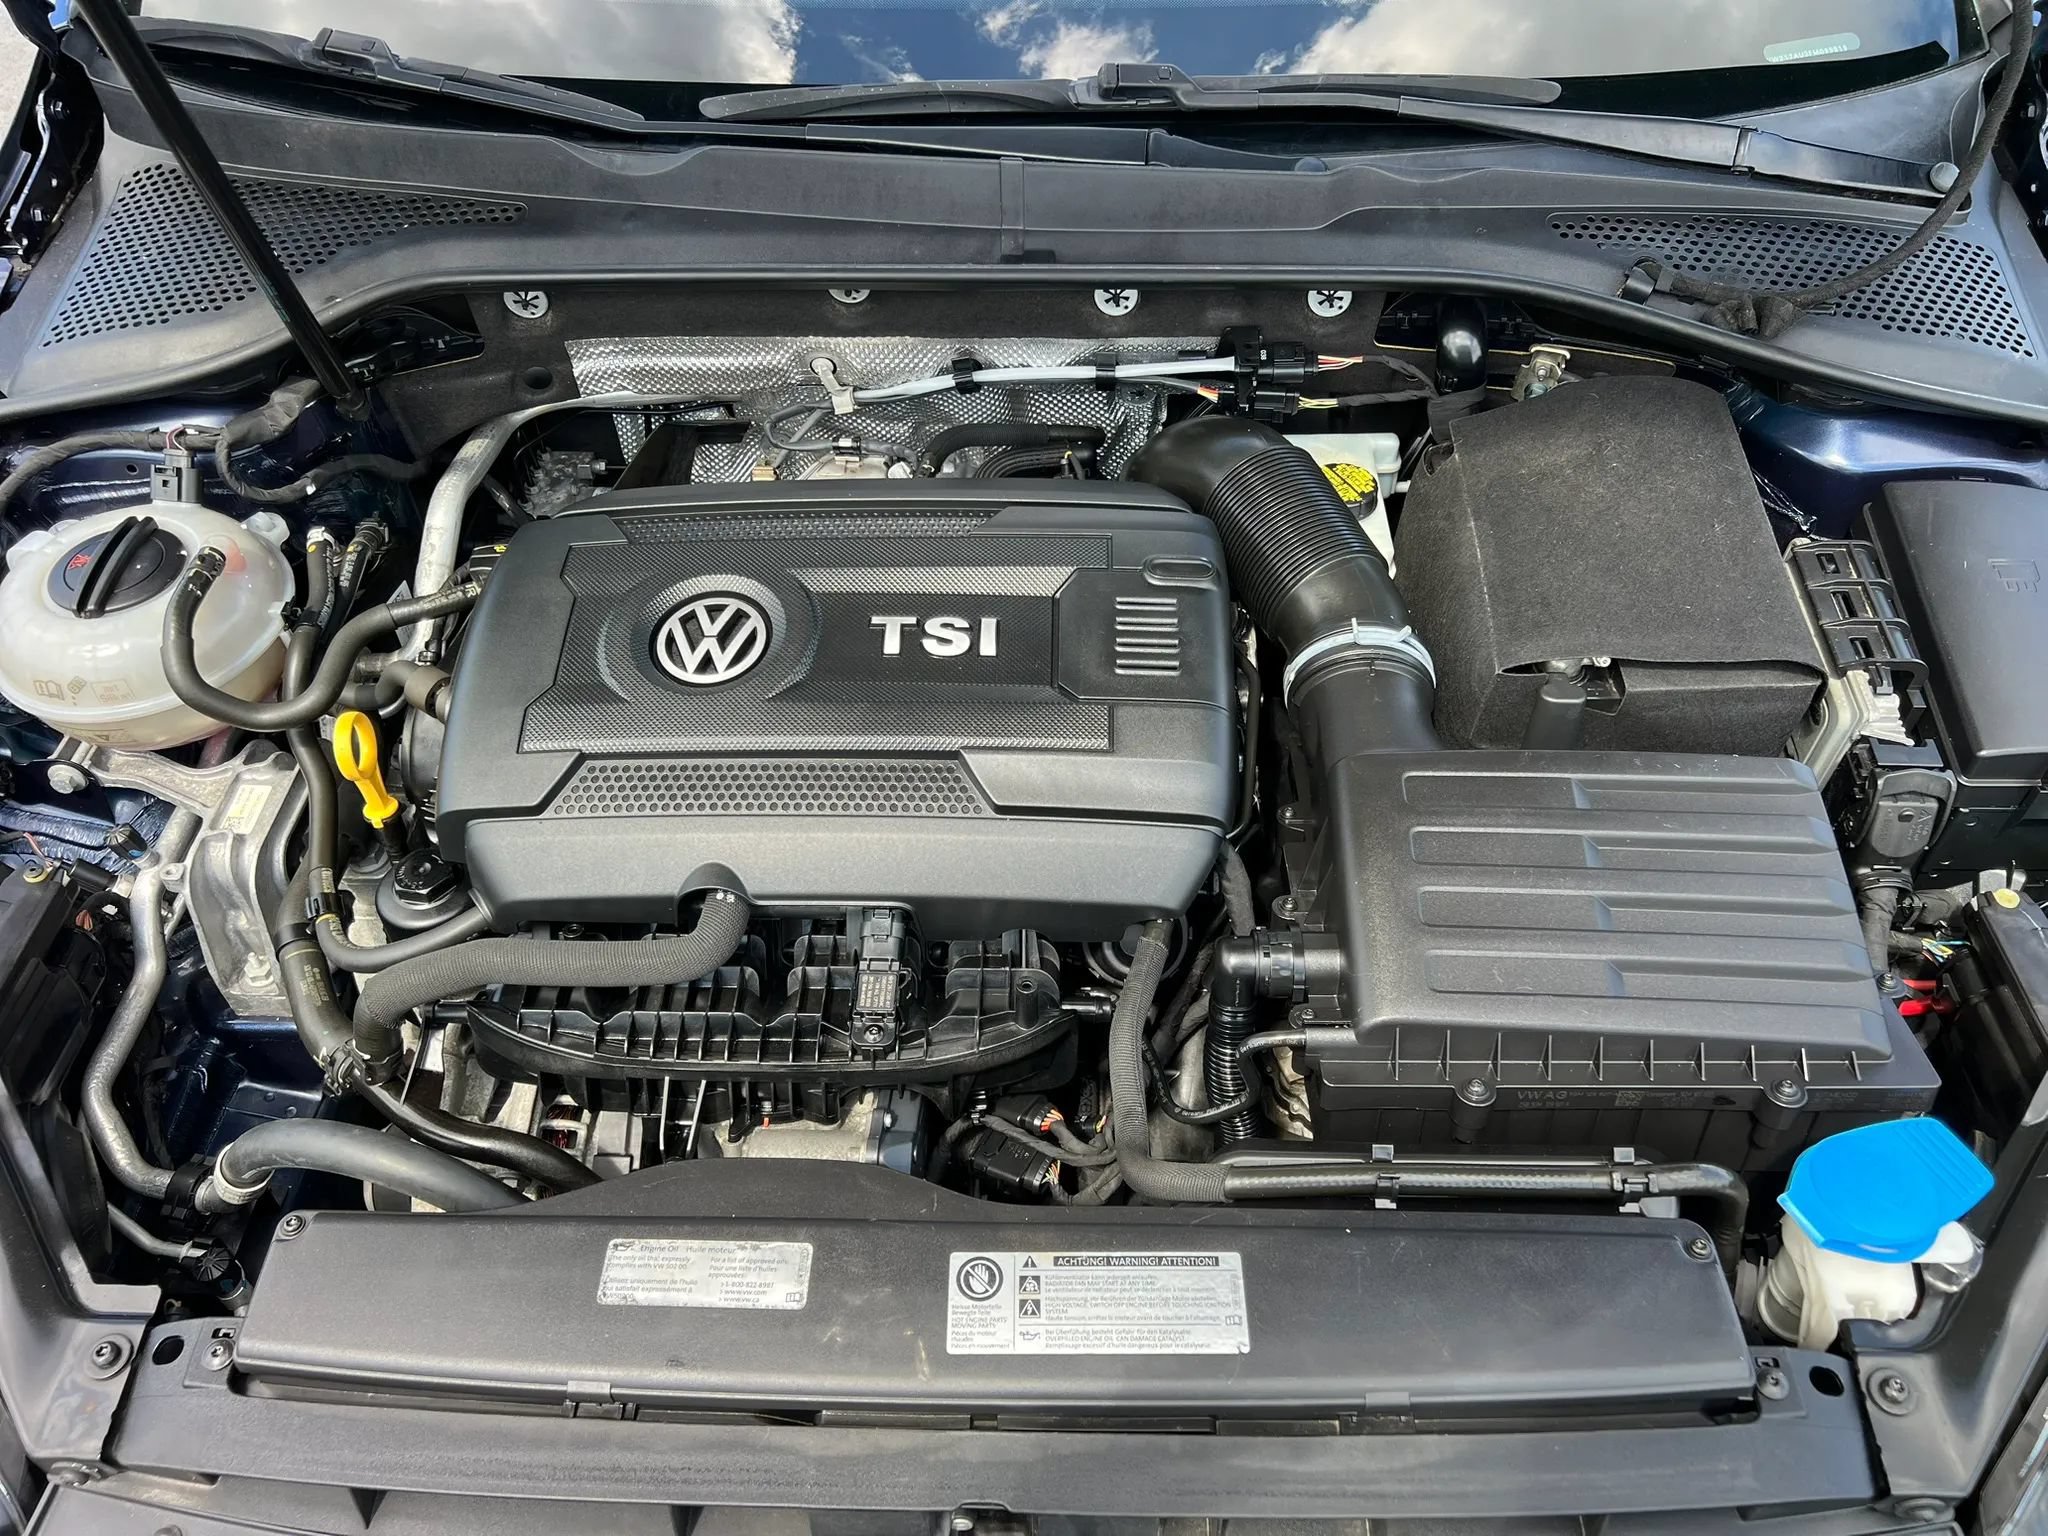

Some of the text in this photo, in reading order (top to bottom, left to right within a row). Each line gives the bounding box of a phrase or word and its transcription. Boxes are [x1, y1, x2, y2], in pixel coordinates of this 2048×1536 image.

[870, 614, 998, 657] TSI
[640, 1244, 679, 1252] Engine Oil
[686, 1246, 736, 1254] Huile moteur
[1057, 1257, 1216, 1266] ACHTUNG! WARNING! ATTENTION!
